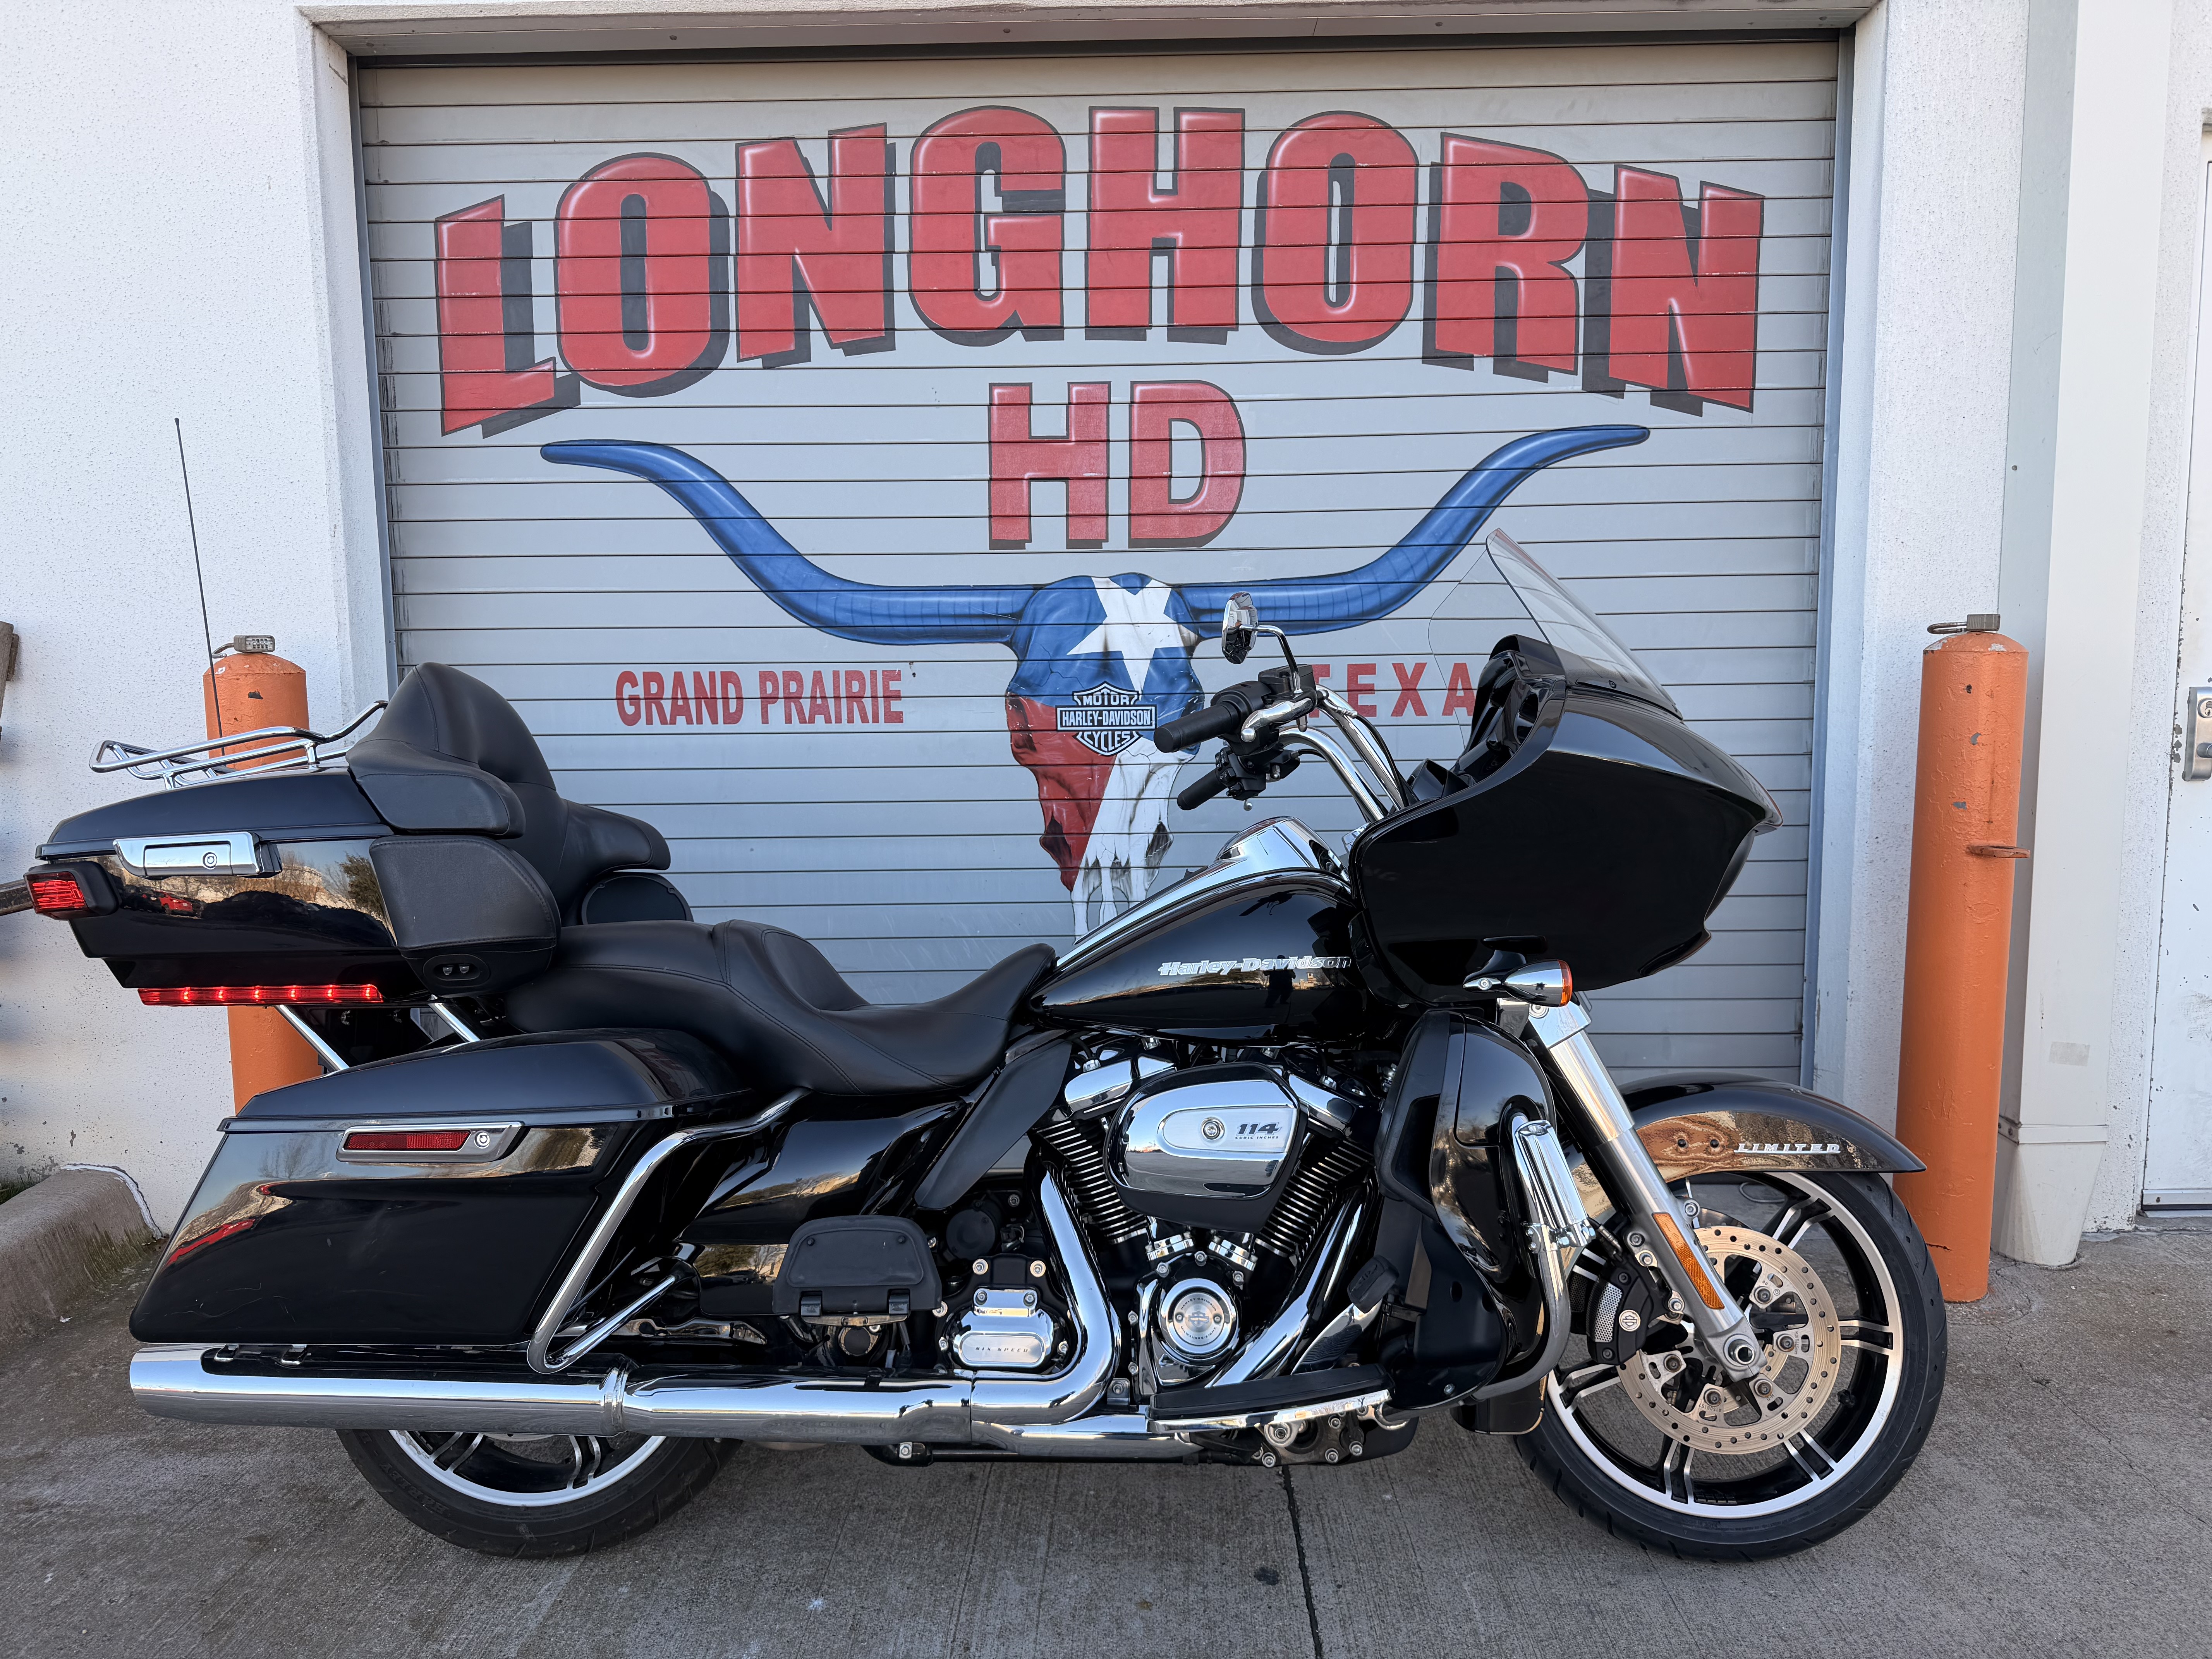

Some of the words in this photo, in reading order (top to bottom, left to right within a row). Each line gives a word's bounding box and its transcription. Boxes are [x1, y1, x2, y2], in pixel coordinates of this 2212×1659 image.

[434, 105, 1765, 438] LONGHORN
[988, 380, 1247, 550] HD
[616, 670, 744, 726] GRAND
[759, 670, 904, 725] PRAIRIE
[1083, 689, 1130, 706] MOTOR
[1062, 710, 1151, 726] HARLEY-DAVIDSON
[1084, 731, 1131, 752] CYCLES
[1158, 955, 1352, 976] Harley-Davidson
[1236, 1122, 1282, 1135] 114
[1734, 1143, 1841, 1154] LIMITED
